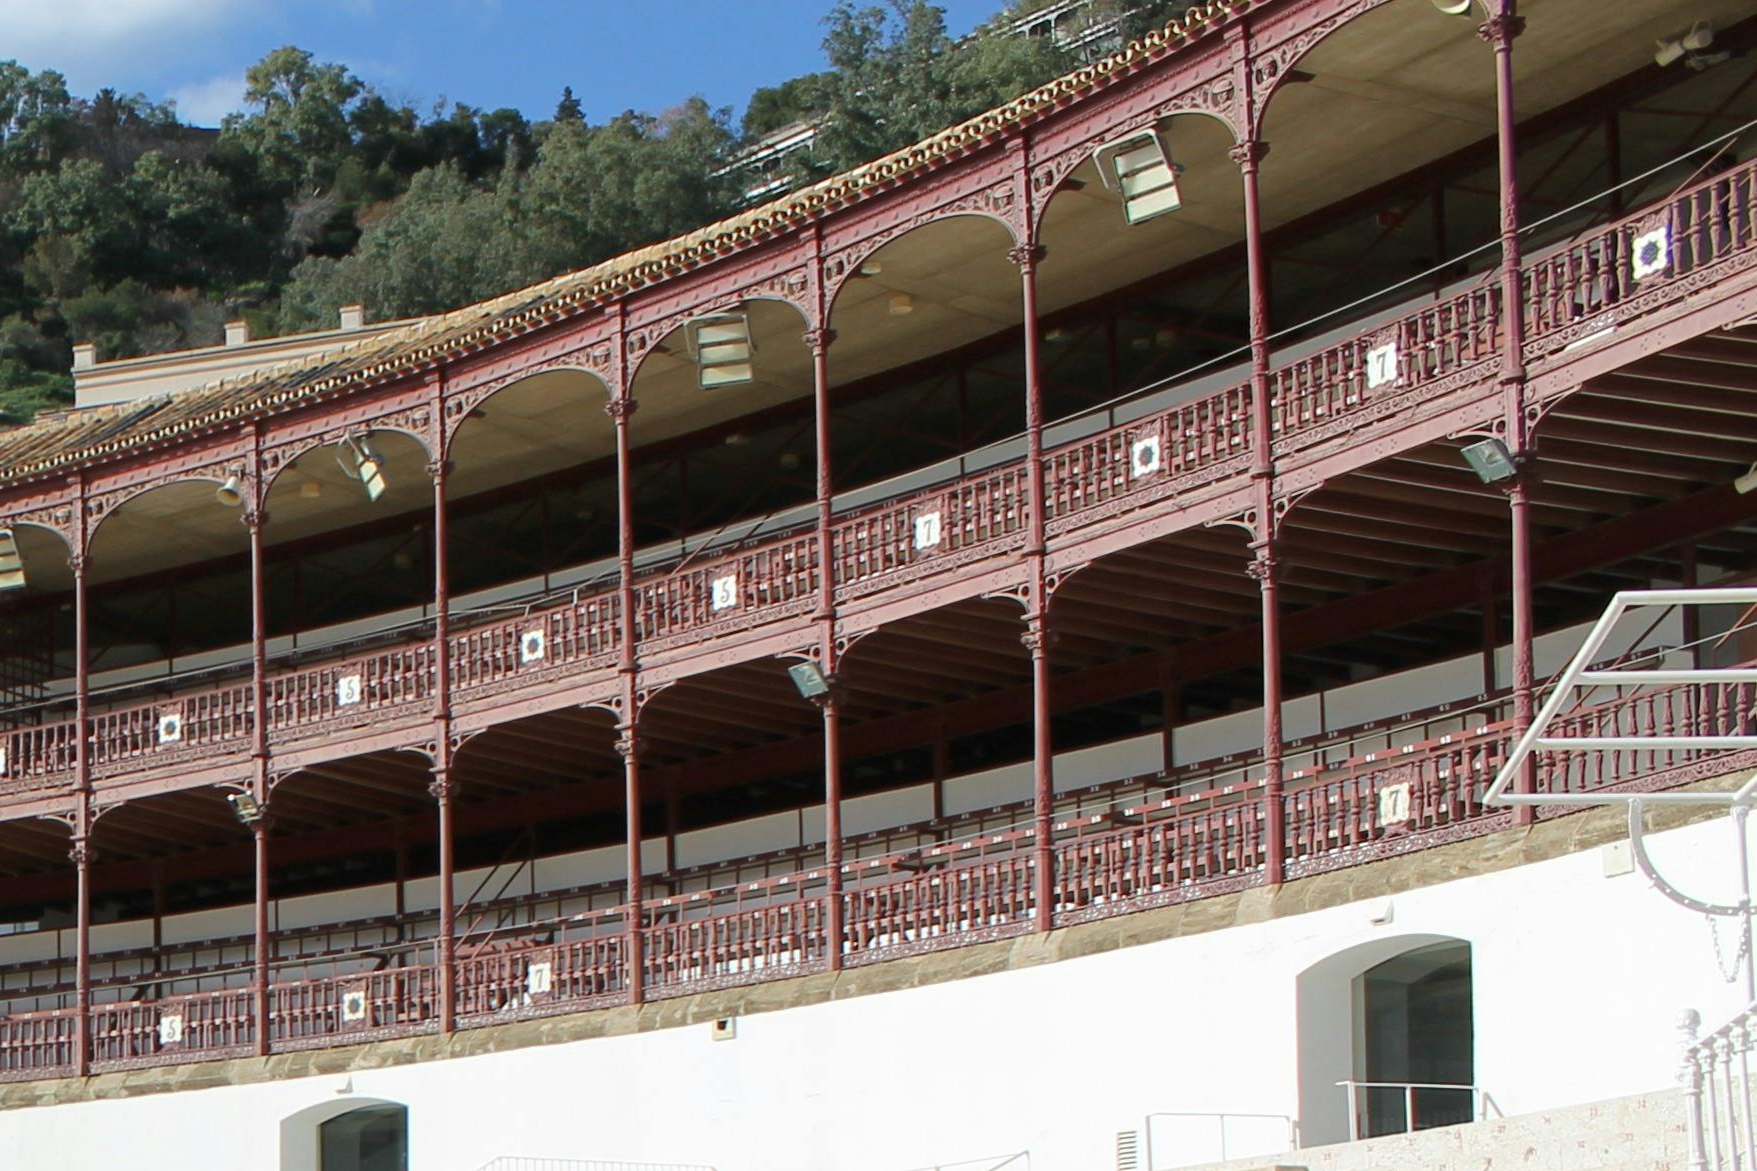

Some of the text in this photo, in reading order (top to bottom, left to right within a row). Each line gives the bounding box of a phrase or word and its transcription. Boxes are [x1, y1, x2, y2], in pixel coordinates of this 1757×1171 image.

[1376, 350, 1387, 379] 7
[924, 518, 933, 542] 7
[721, 580, 729, 603] 5
[346, 679, 355, 701] 5
[1388, 789, 1400, 817] 7
[536, 968, 544, 989] 7
[167, 1019, 176, 1039] 5
